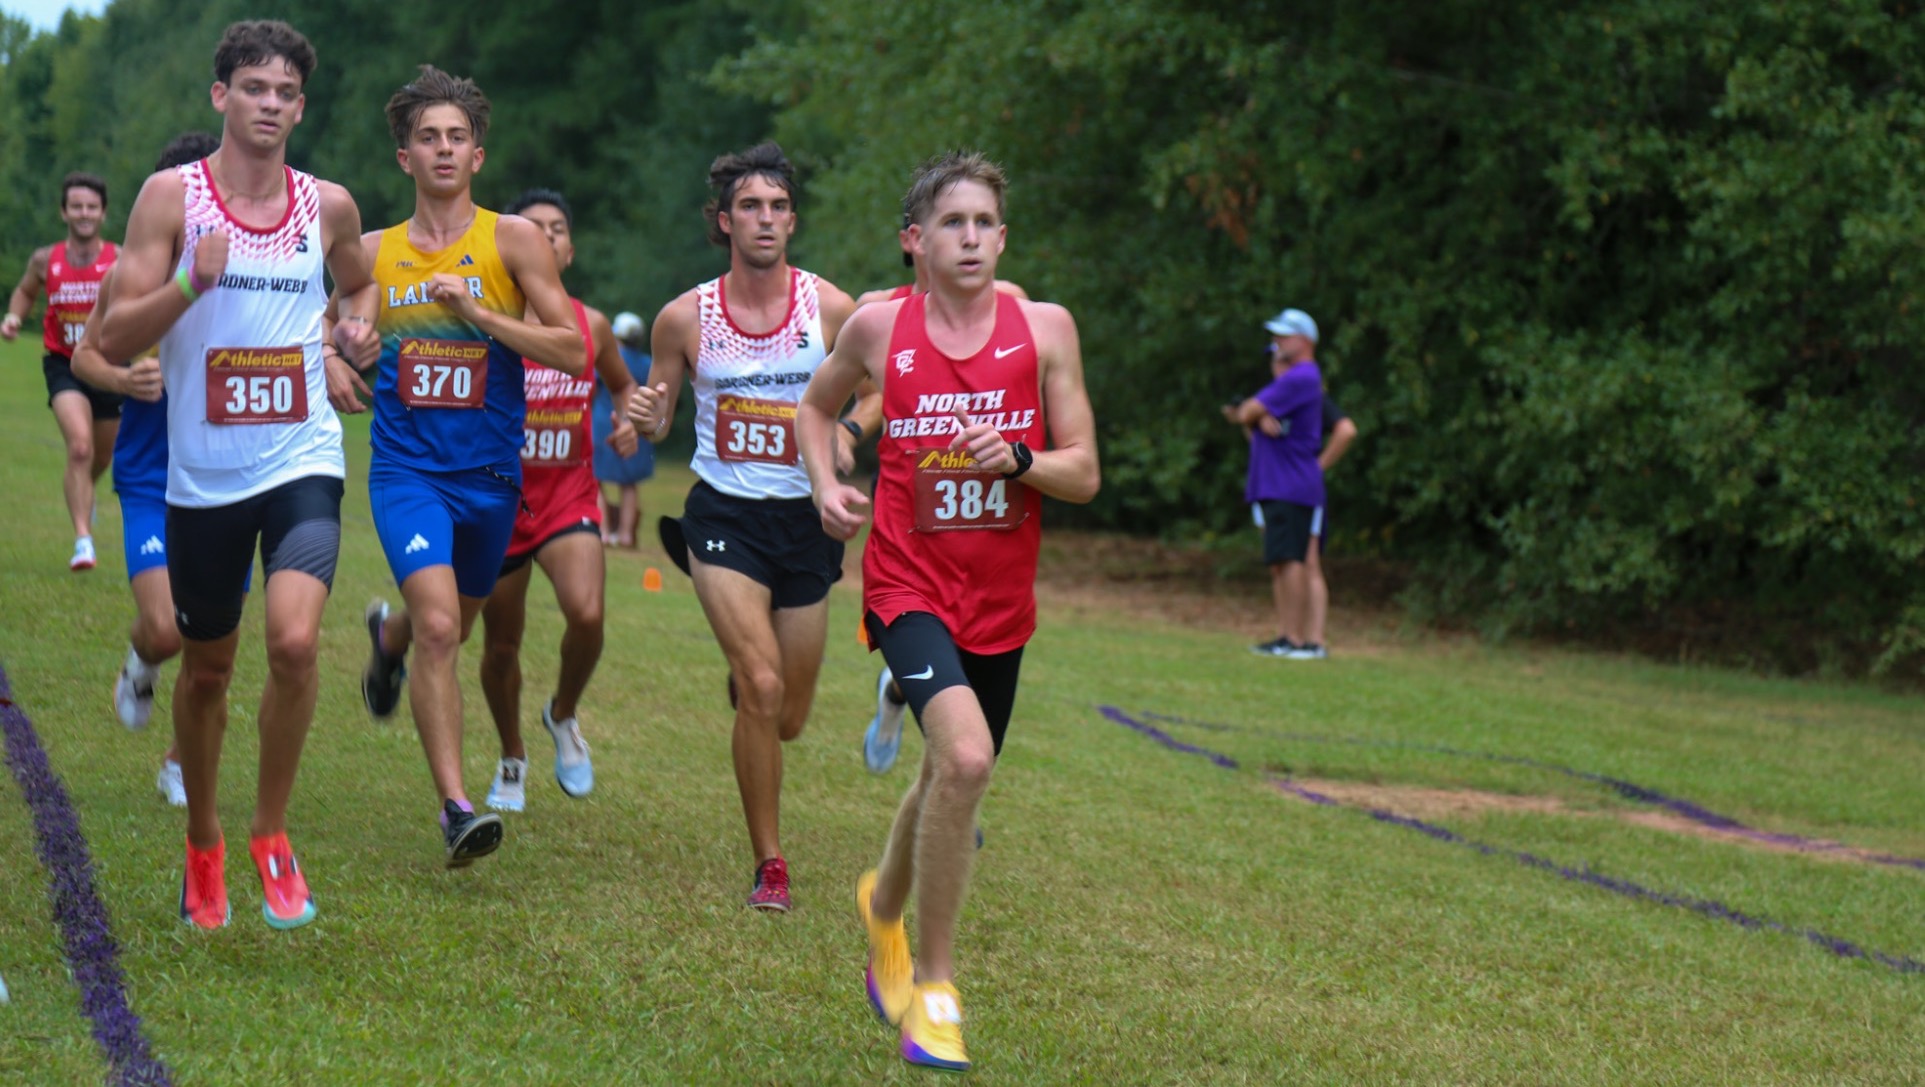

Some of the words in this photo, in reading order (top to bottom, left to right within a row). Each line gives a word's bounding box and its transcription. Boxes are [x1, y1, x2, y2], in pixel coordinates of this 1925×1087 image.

[218, 272, 309, 294] RDNER-WEBB
[225, 375, 293, 414] 350
[412, 364, 472, 399] 370
[915, 389, 1007, 415] NORTH
[520, 428, 571, 460] 390
[727, 420, 786, 457] 353
[918, 450, 978, 469] Athle
[934, 479, 1009, 520] 384
